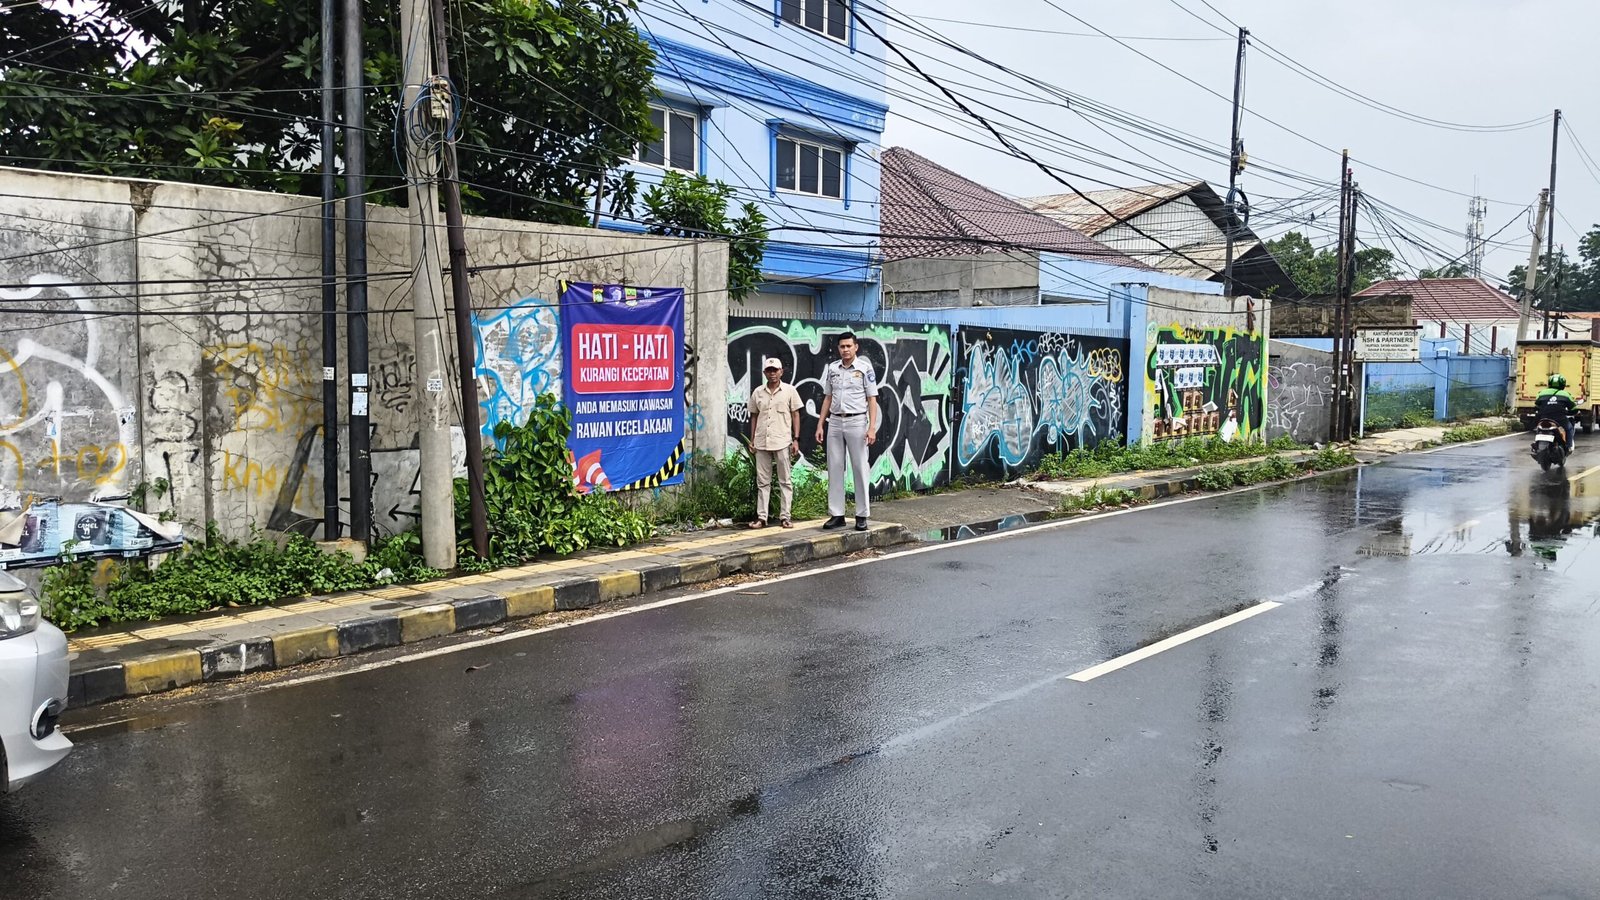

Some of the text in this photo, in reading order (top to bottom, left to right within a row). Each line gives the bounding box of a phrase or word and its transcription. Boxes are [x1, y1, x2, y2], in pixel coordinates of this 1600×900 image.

[578, 333, 618, 360] HATI
[633, 334, 668, 360] HATI
[580, 366, 669, 383] KURANGI KECEPATAN
[576, 398, 673, 414] ANDA MEMASUKI KAWASAN
[576, 417, 673, 439] RAWAN KECELAKAAN
